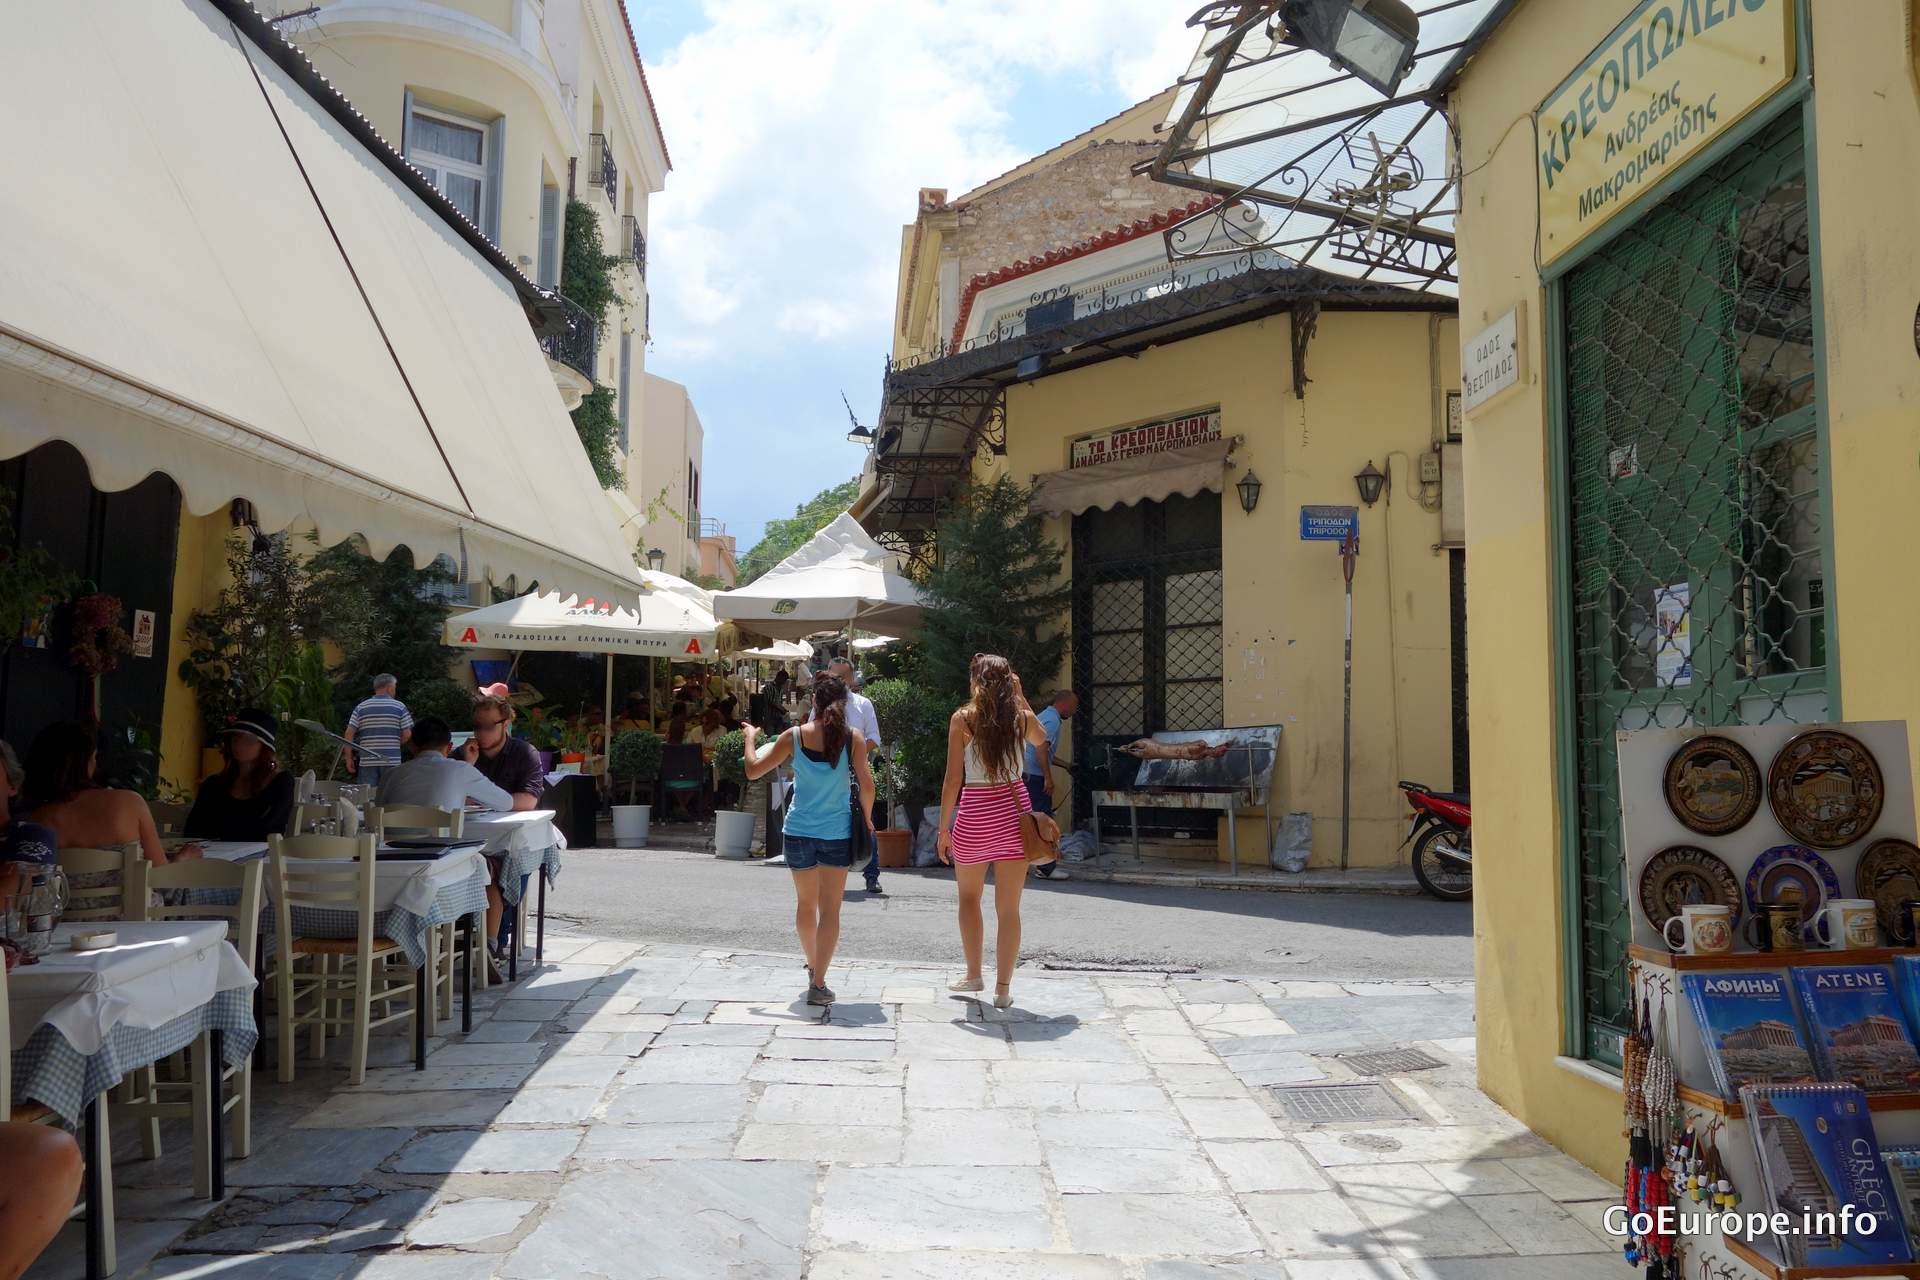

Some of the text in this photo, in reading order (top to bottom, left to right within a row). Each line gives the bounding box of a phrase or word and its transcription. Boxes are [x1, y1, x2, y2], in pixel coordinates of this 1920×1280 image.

[1541, 0, 1766, 190] ΚΡΕΟΠΩΛΕ
[1604, 80, 1681, 163] Ανδρέας
[1578, 93, 1718, 221] Μακρομαρίδης
[1476, 334, 1501, 362] ΟΔΟΣ
[1467, 354, 1513, 397] ΘΕΣΠΙΔΟΣ
[1088, 416, 1209, 454] ΤΟ ΚΡΕΟΠΩΛΕΙΟΝ
[636, 639, 668, 648] ΜΠΥΡΑ
[1704, 977, 1780, 994] АФИНЫ
[1815, 973, 1886, 988] ATENE
